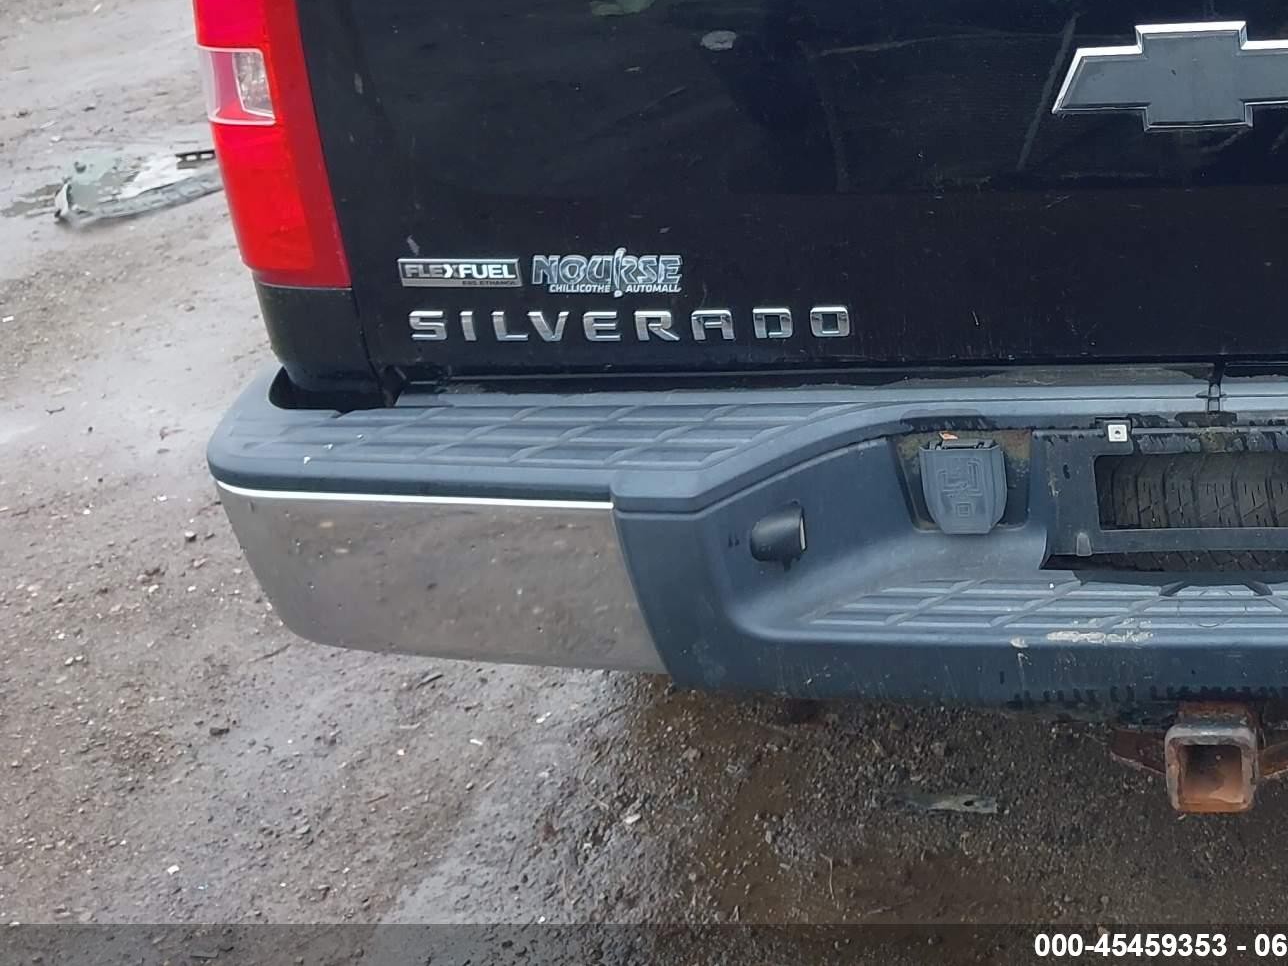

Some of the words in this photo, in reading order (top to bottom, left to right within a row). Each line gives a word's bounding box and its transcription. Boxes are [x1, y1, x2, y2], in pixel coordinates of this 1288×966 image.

[532, 250, 683, 286] NOURSE
[549, 284, 611, 294] CHILLICOTHE
[625, 284, 682, 294] AUTOMALL
[408, 305, 853, 342] SILVERADO
